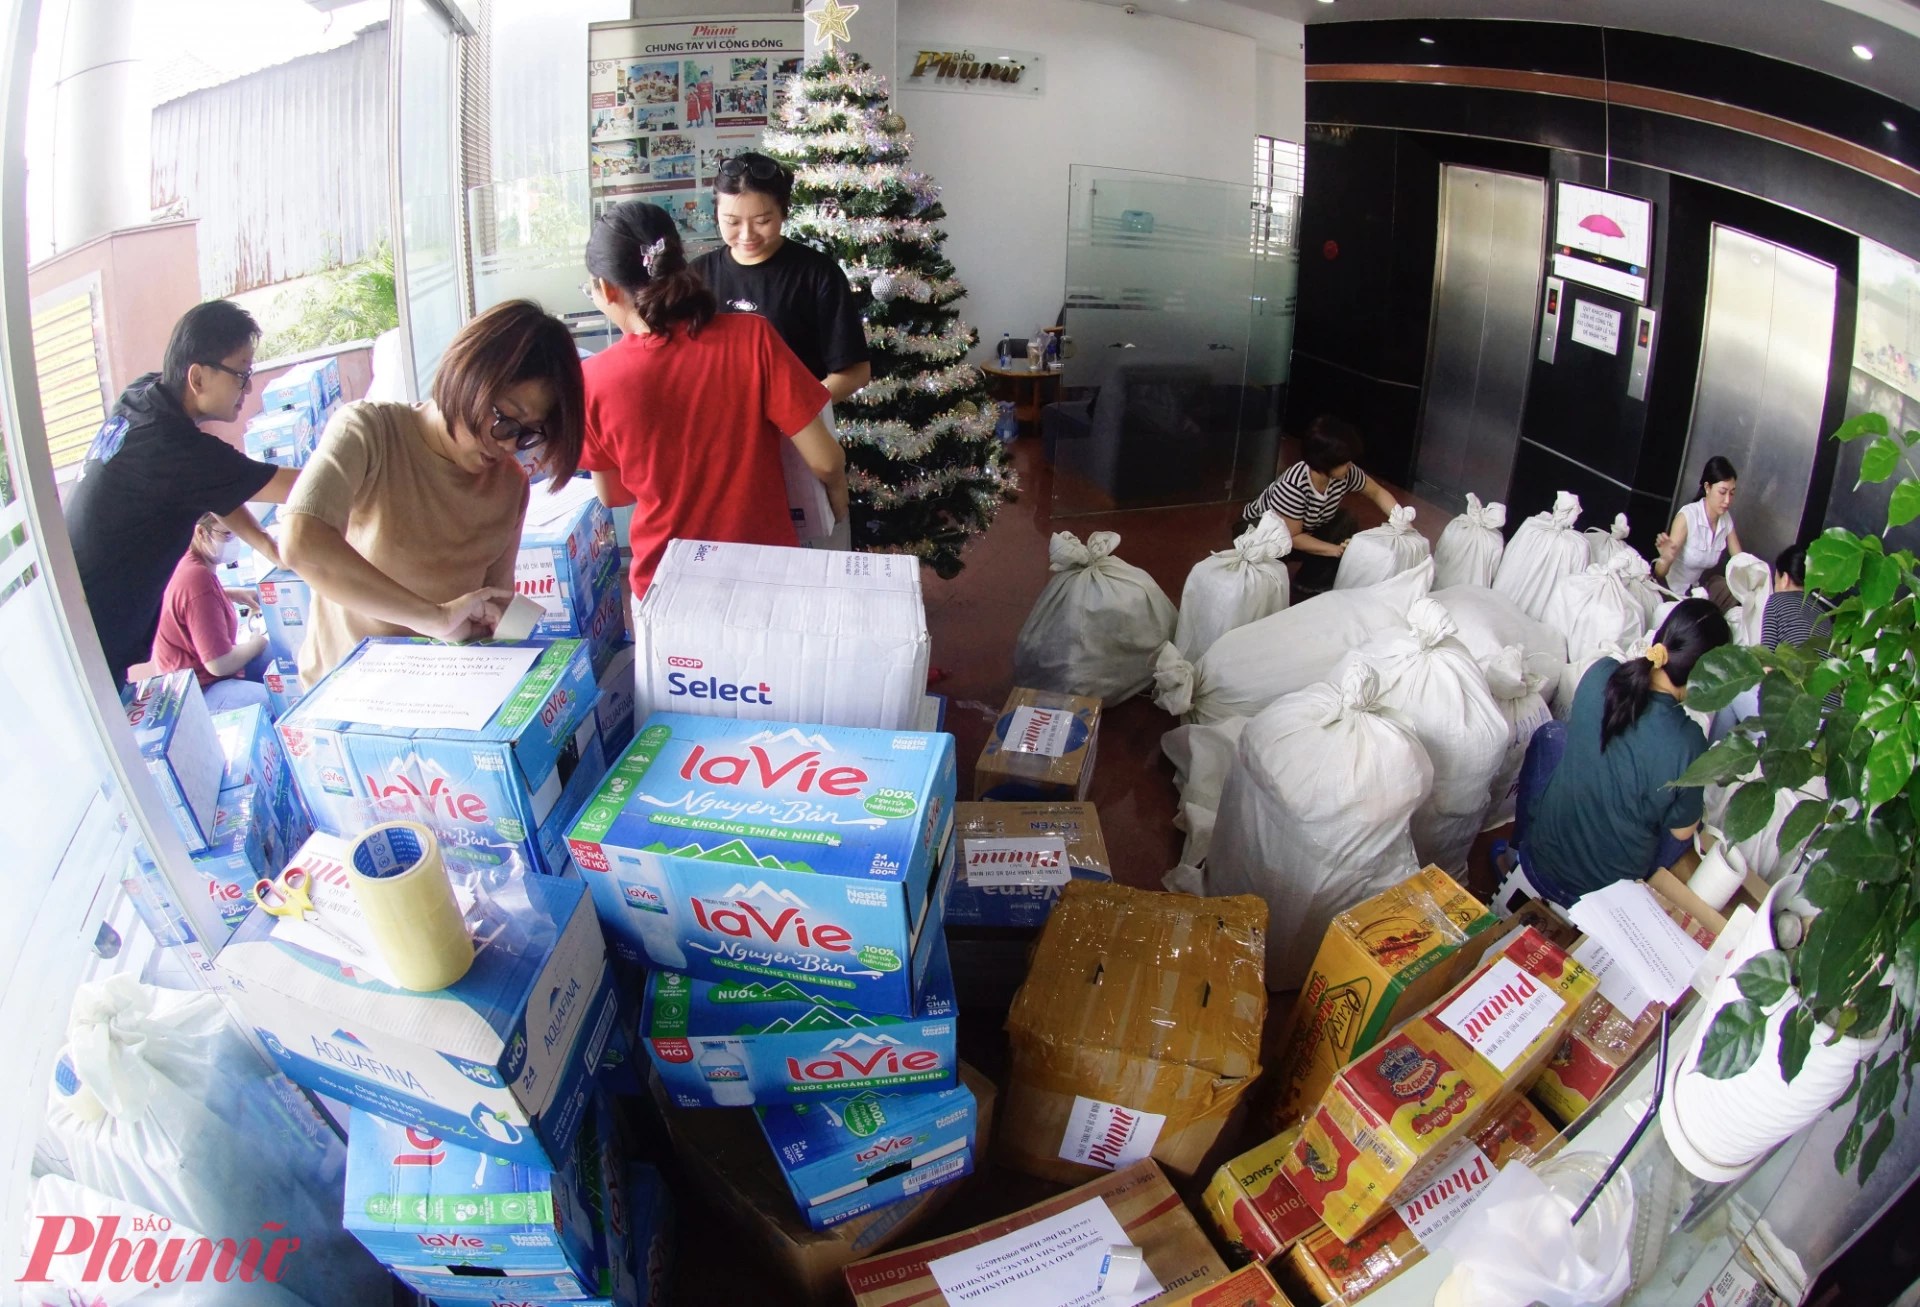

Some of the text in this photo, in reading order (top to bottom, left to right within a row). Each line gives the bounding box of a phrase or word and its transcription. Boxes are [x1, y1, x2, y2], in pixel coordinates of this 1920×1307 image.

[645, 39, 783, 53] CHUNG TAY VÌ CỘNG ĐỒNG
[954, 50, 975, 61] BÁO
[670, 657, 702, 667] COOP
[669, 672, 773, 705] Select
[540, 688, 568, 728] laVie
[679, 745, 869, 797] laVie
[878, 788, 914, 799] 100%
[655, 791, 782, 821] Nguyên
[653, 813, 686, 825] NƯỚC
[692, 817, 744, 834] KHOÁNG
[749, 825, 787, 838] THIÊN
[872, 860, 899, 868] CHAI
[626, 887, 658, 901] laVie
[846, 888, 887, 901] Nestlé
[848, 898, 888, 907] Waters
[691, 897, 853, 953] laVie
[705, 941, 798, 965] Nguyên
[863, 945, 895, 957] 100%
[786, 971, 816, 983] THIÊN
[819, 977, 852, 988] NHIÊN
[926, 994, 937, 1002] 24
[926, 999, 951, 1008] CHAI
[544, 977, 581, 1056] AQUAFINA
[661, 1048, 688, 1057] MỚI
[311, 1035, 432, 1098] AQUAFINA
[787, 1046, 939, 1081] laVie
[523, 1065, 535, 1090] 24
[708, 1070, 741, 1078] laVie
[793, 1072, 943, 1091] NƯỚC KHOÁNG THIÊN NHIÊN
[867, 1100, 888, 1127] 100%
[855, 1135, 914, 1163] laVie
[1241, 1164, 1274, 1187] SAUCE
[417, 1234, 485, 1248] laVie
[1020, 1240, 1042, 1252] Hạnh
[944, 1228, 1099, 1294] 77 YERSIN NHA TRANG, KHÁNH HÒA
[975, 1249, 1020, 1272] 0989446275
[1041, 1257, 1055, 1269] VÀ
[1055, 1250, 1074, 1263] BÁO
[1017, 1264, 1041, 1280] PTTH
[982, 1274, 1016, 1292] KHÁNH
[959, 1288, 981, 1301] HÒA
